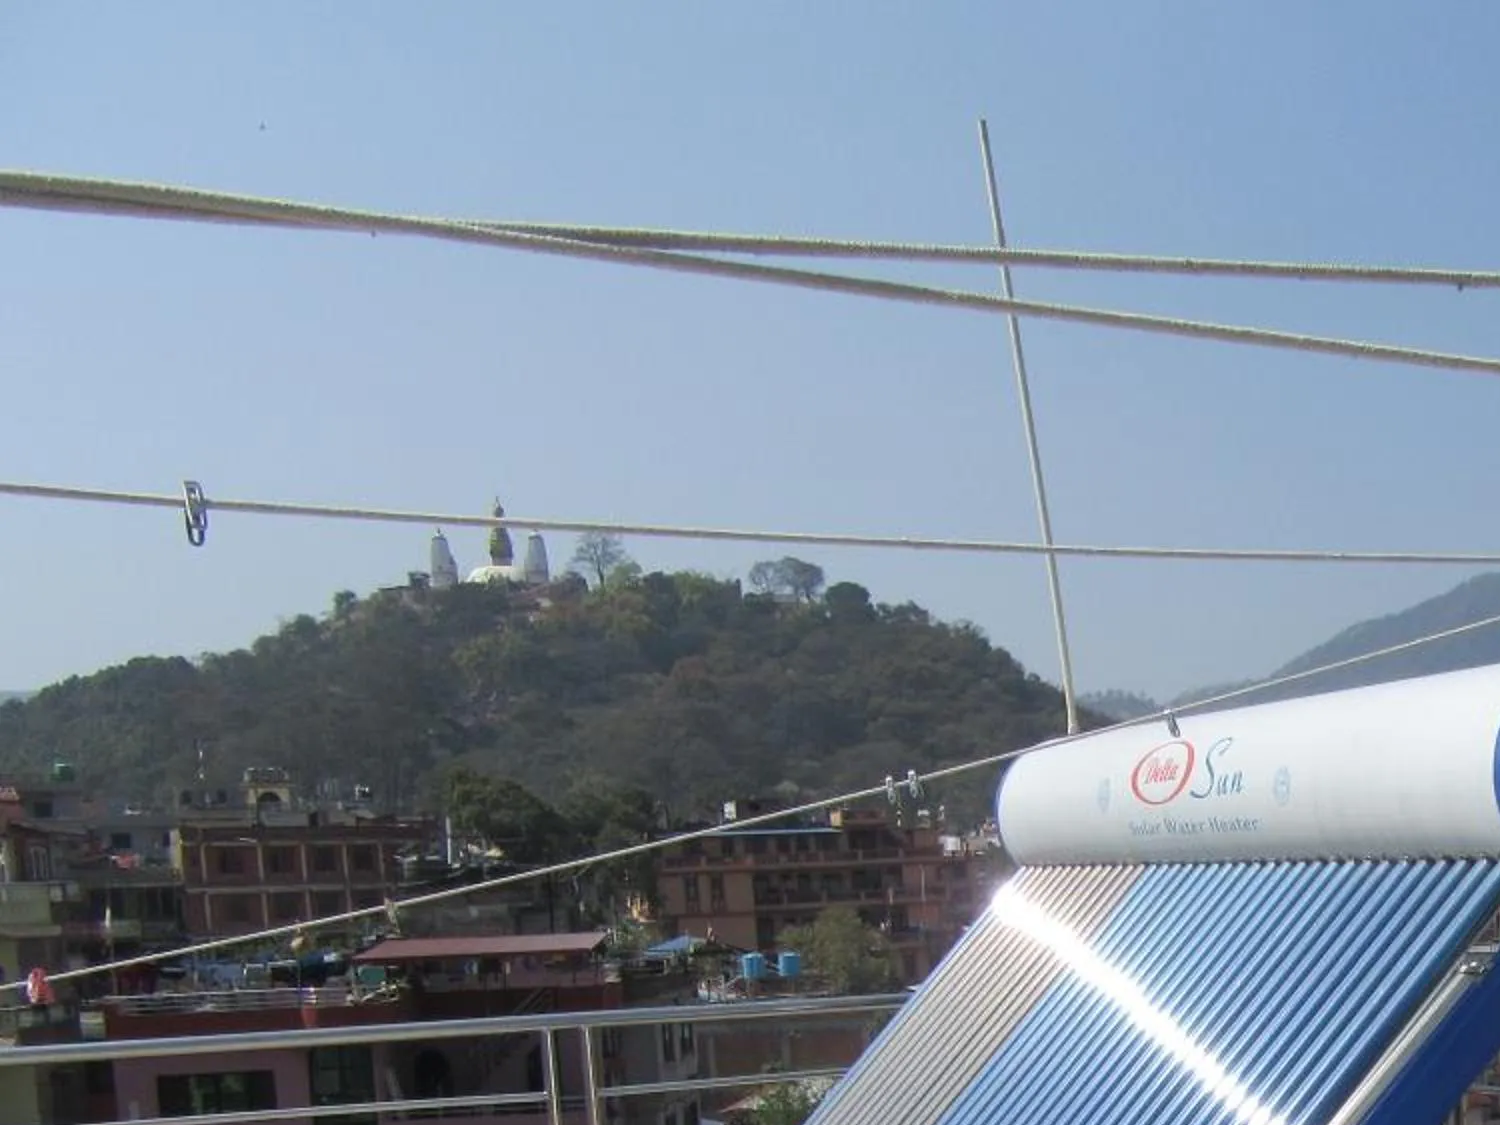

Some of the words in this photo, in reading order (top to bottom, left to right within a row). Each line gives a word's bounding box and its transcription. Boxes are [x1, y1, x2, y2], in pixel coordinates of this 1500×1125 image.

[1190, 736, 1245, 799] Sun
[1128, 819, 1161, 837] Solar
[1163, 816, 1206, 835] Water
[1208, 814, 1258, 834] Heater
